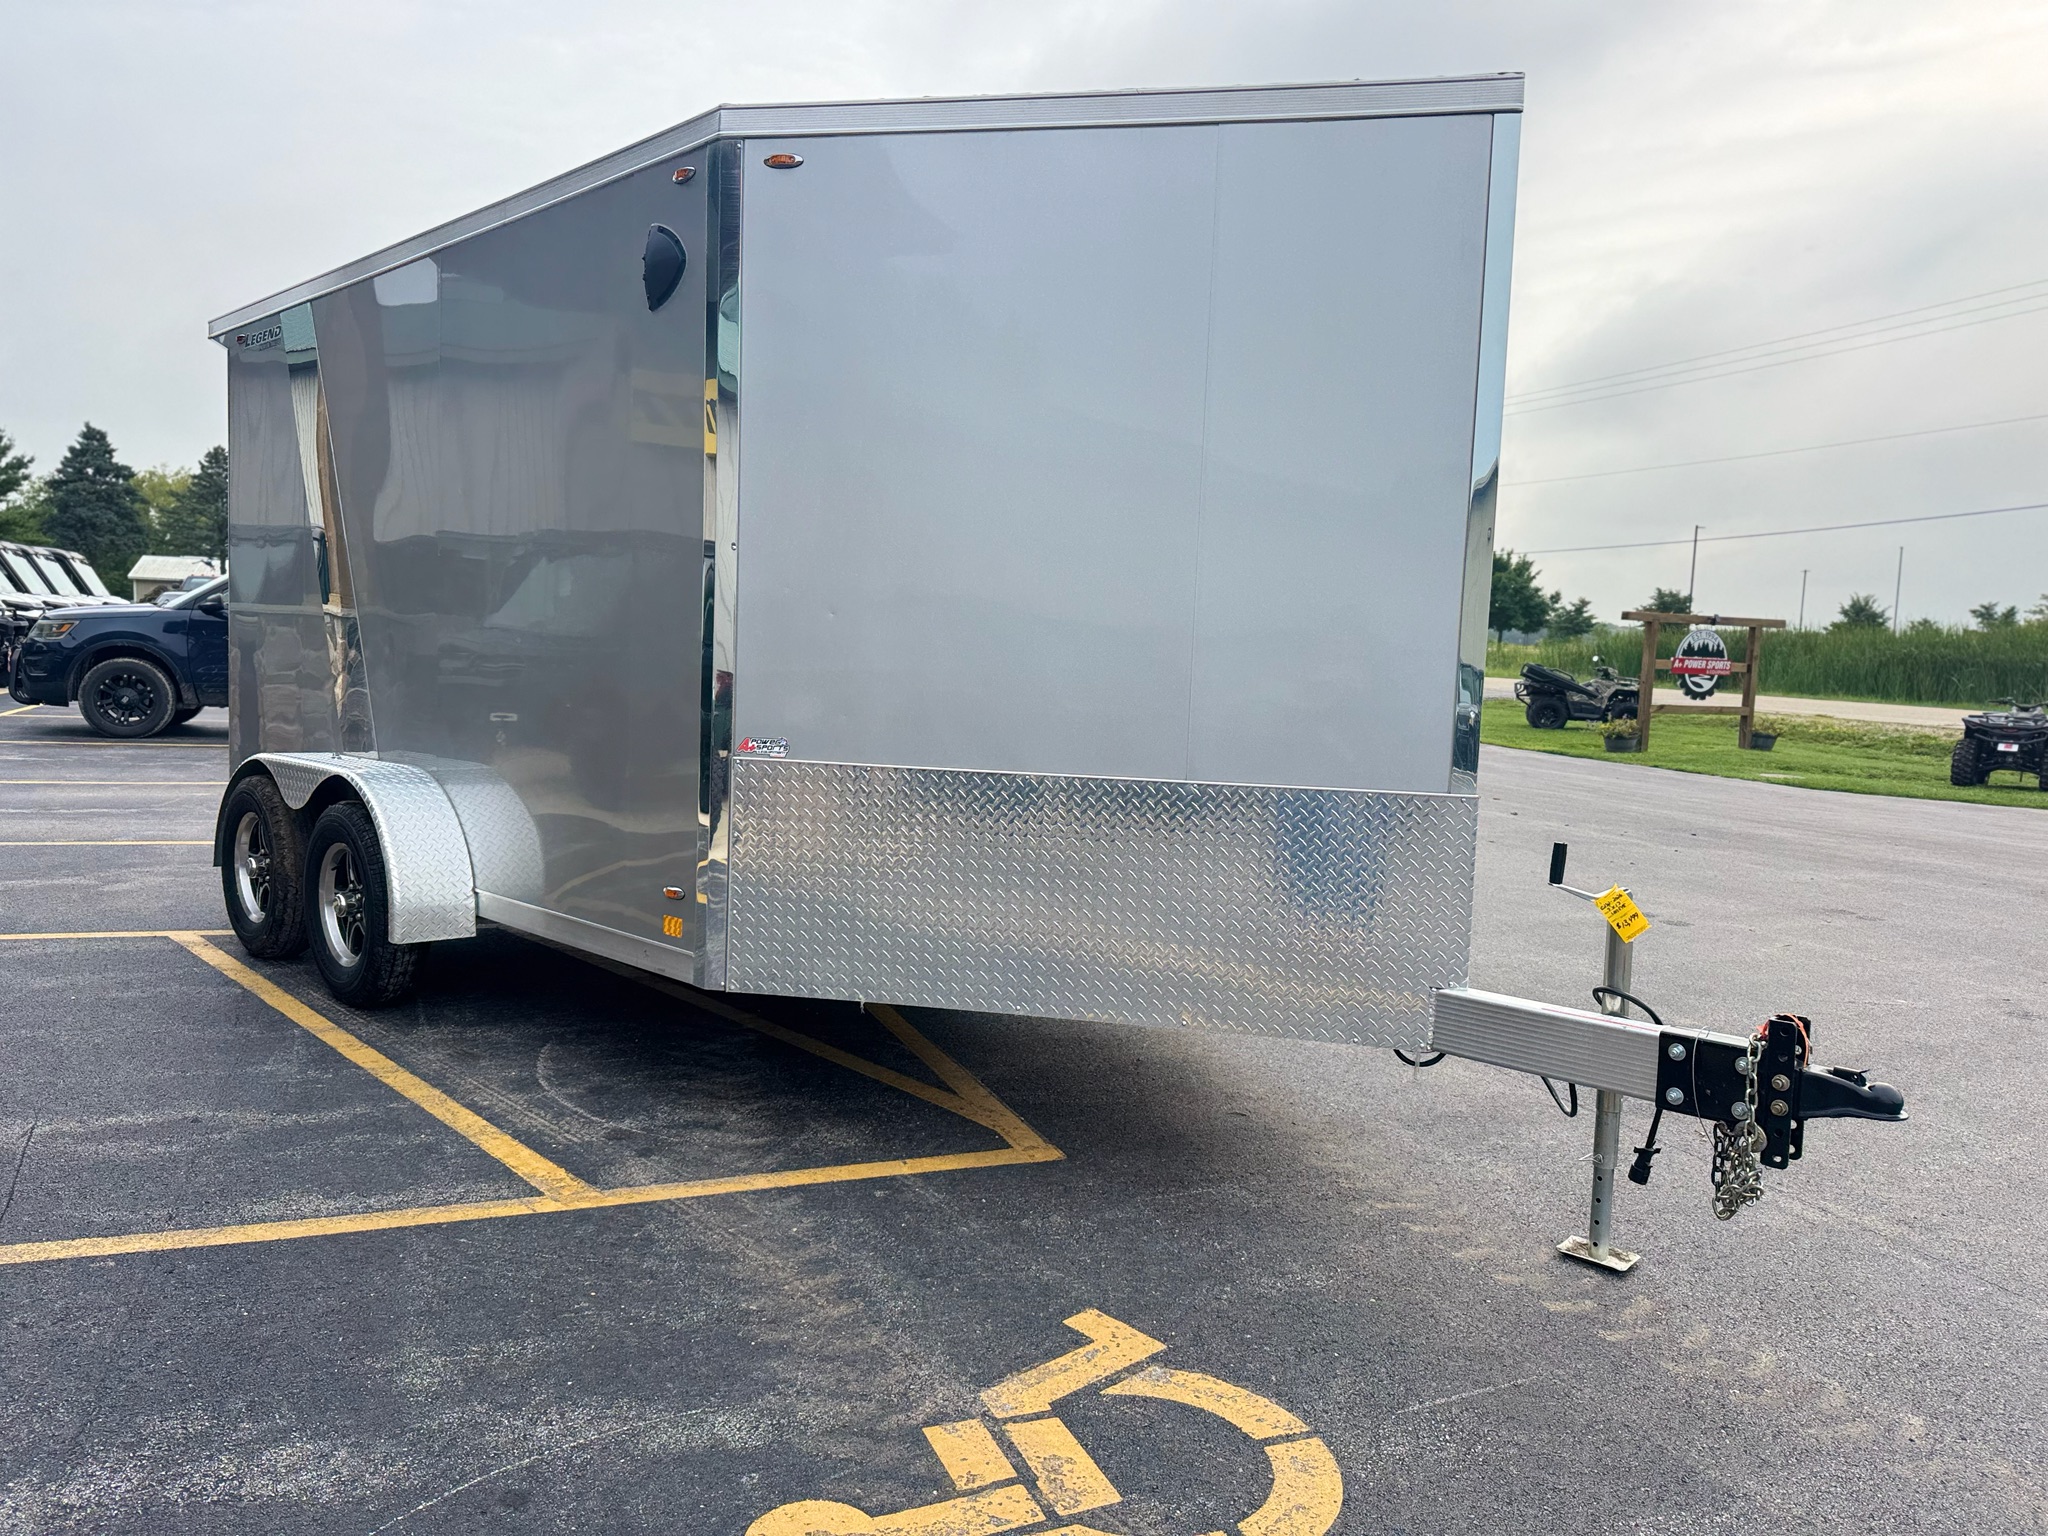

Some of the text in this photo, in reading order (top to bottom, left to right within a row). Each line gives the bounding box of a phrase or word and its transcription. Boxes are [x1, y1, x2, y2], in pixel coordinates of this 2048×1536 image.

[244, 325, 281, 347] LEGEND
[1691, 631, 1719, 643] EST 1994
[1673, 659, 1731, 670] A+ POWER SPORTS
